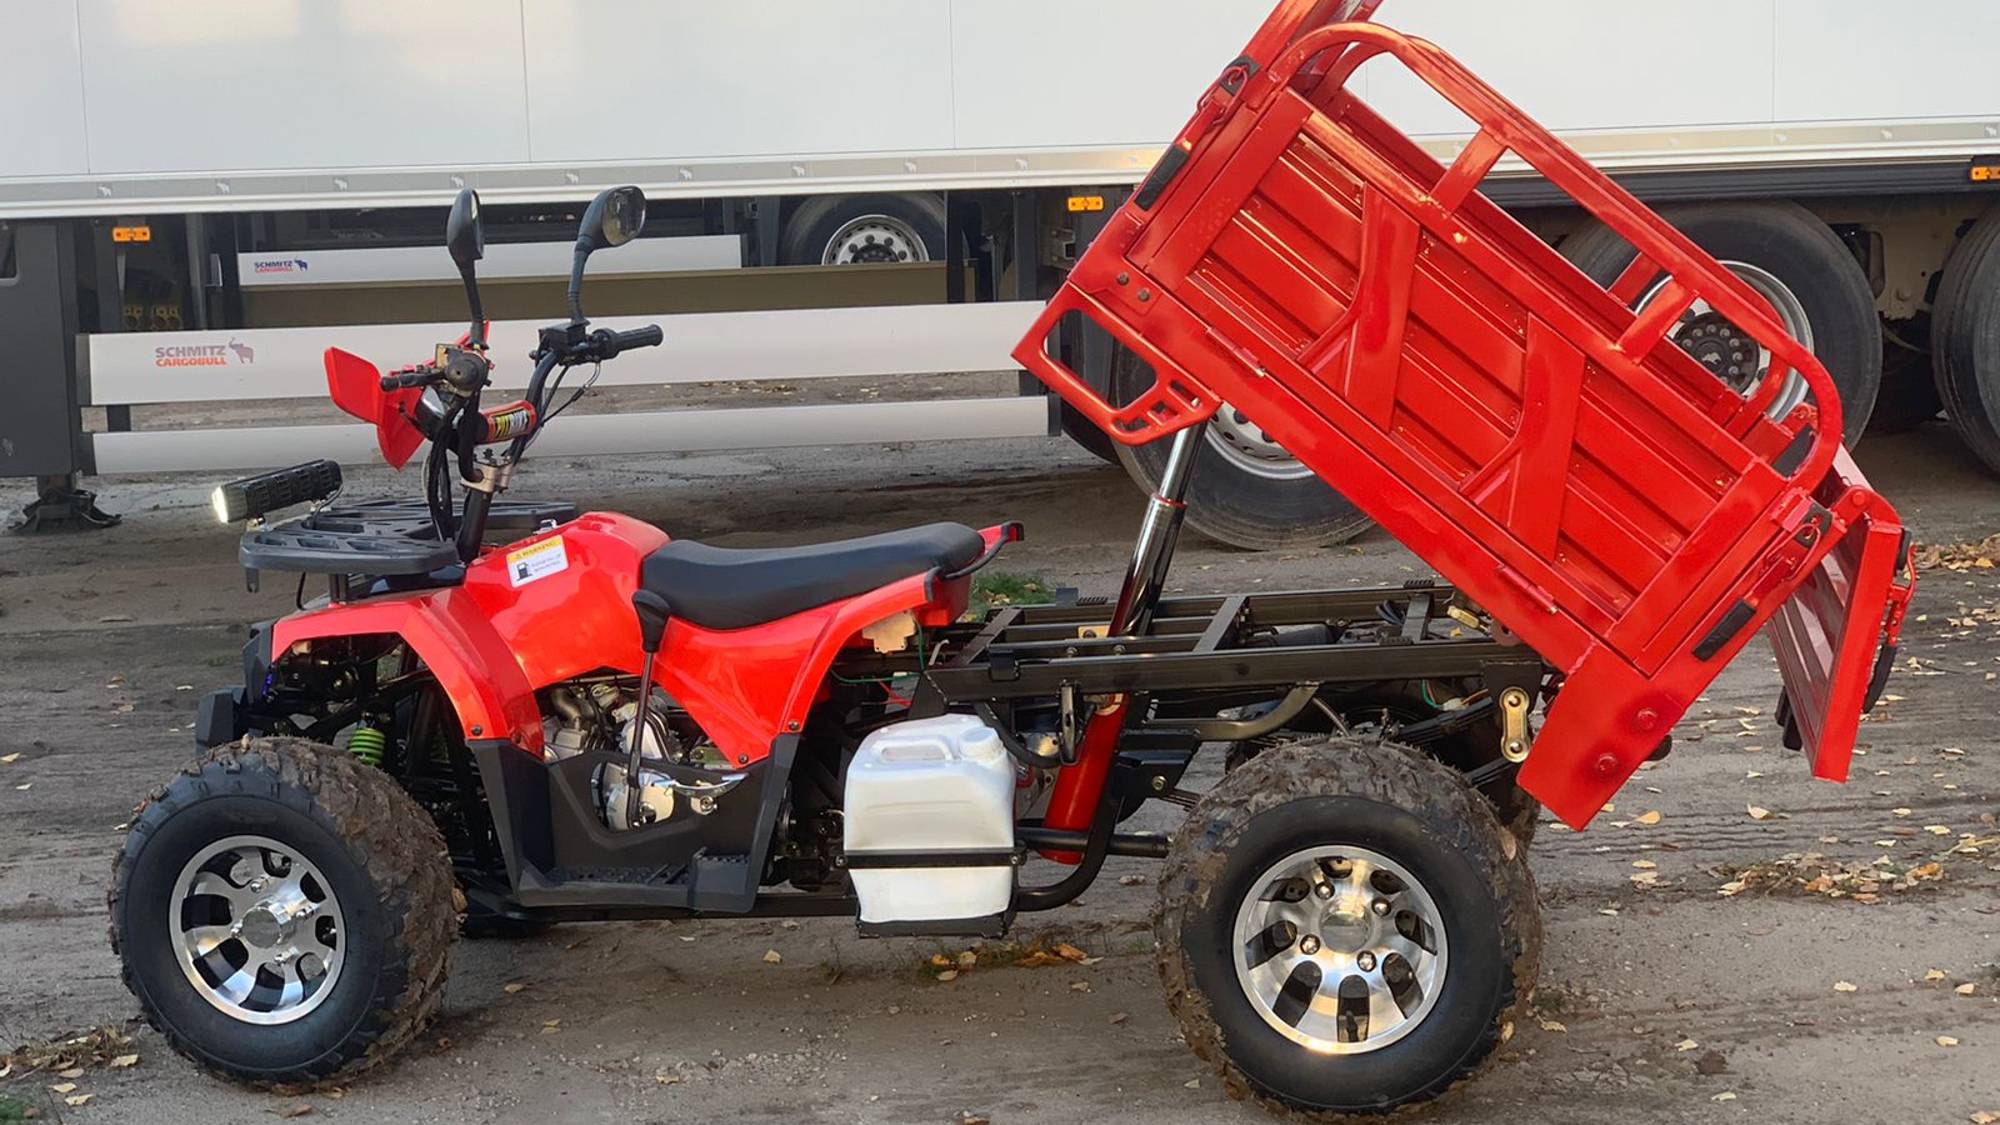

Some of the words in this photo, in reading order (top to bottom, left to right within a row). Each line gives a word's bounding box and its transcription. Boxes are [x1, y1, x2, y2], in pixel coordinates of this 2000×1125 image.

[255, 260, 292, 268] SCHMITZ
[155, 345, 226, 358] SCHMITZ
[155, 357, 226, 367] CARGOBULL
